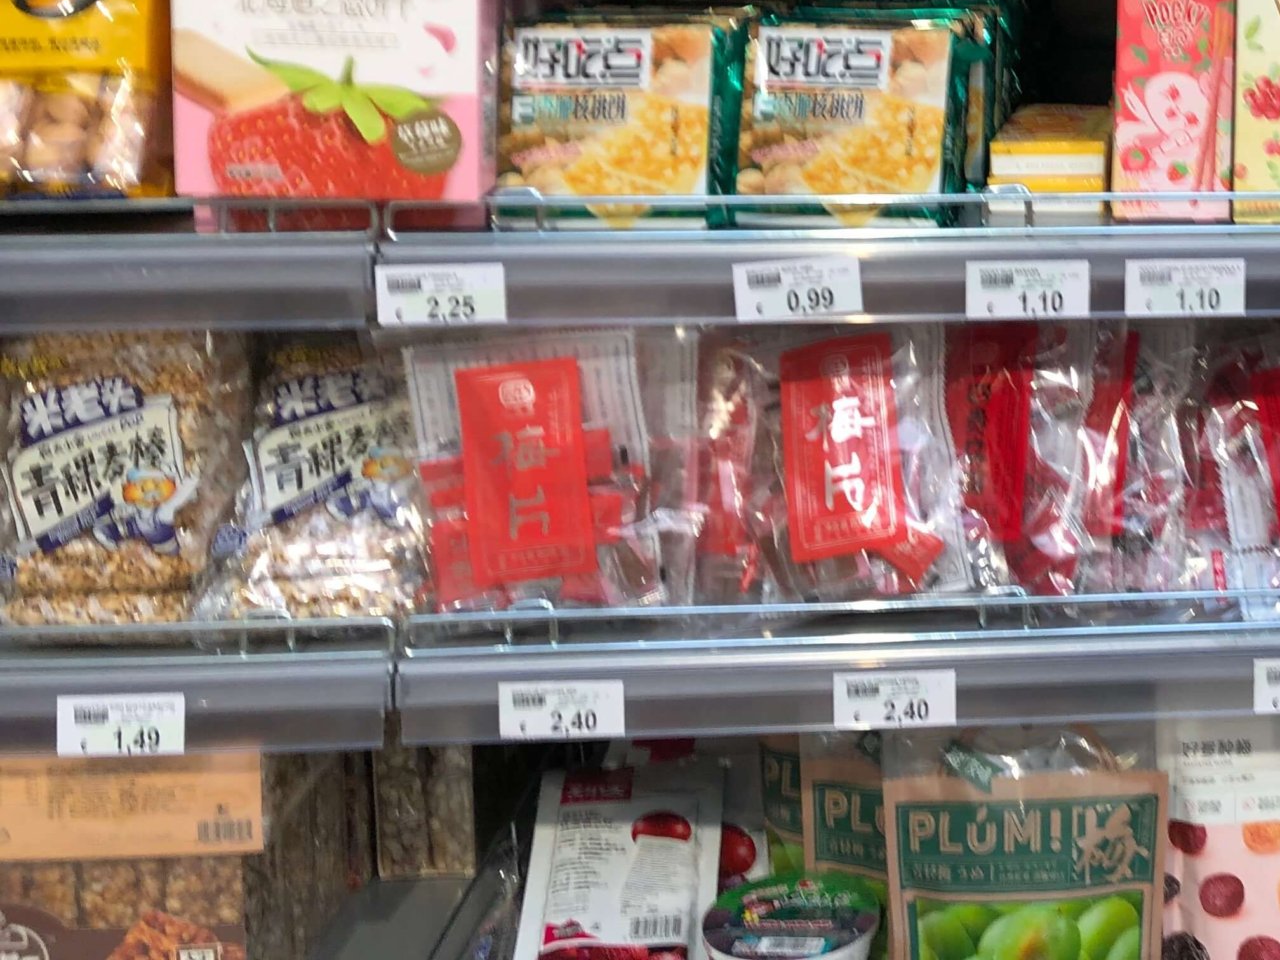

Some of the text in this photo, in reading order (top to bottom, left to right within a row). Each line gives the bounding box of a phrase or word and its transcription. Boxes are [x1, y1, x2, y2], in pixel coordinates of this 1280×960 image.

[426, 296, 476, 323] 2,25
[787, 286, 834, 315] 0,99
[1018, 290, 1063, 319] 1,10
[1176, 287, 1220, 312] 1,10
[550, 711, 597, 738] 2,40
[883, 700, 929, 728] 2,40
[112, 726, 161, 755] 1,49
[824, 788, 886, 834] PL
